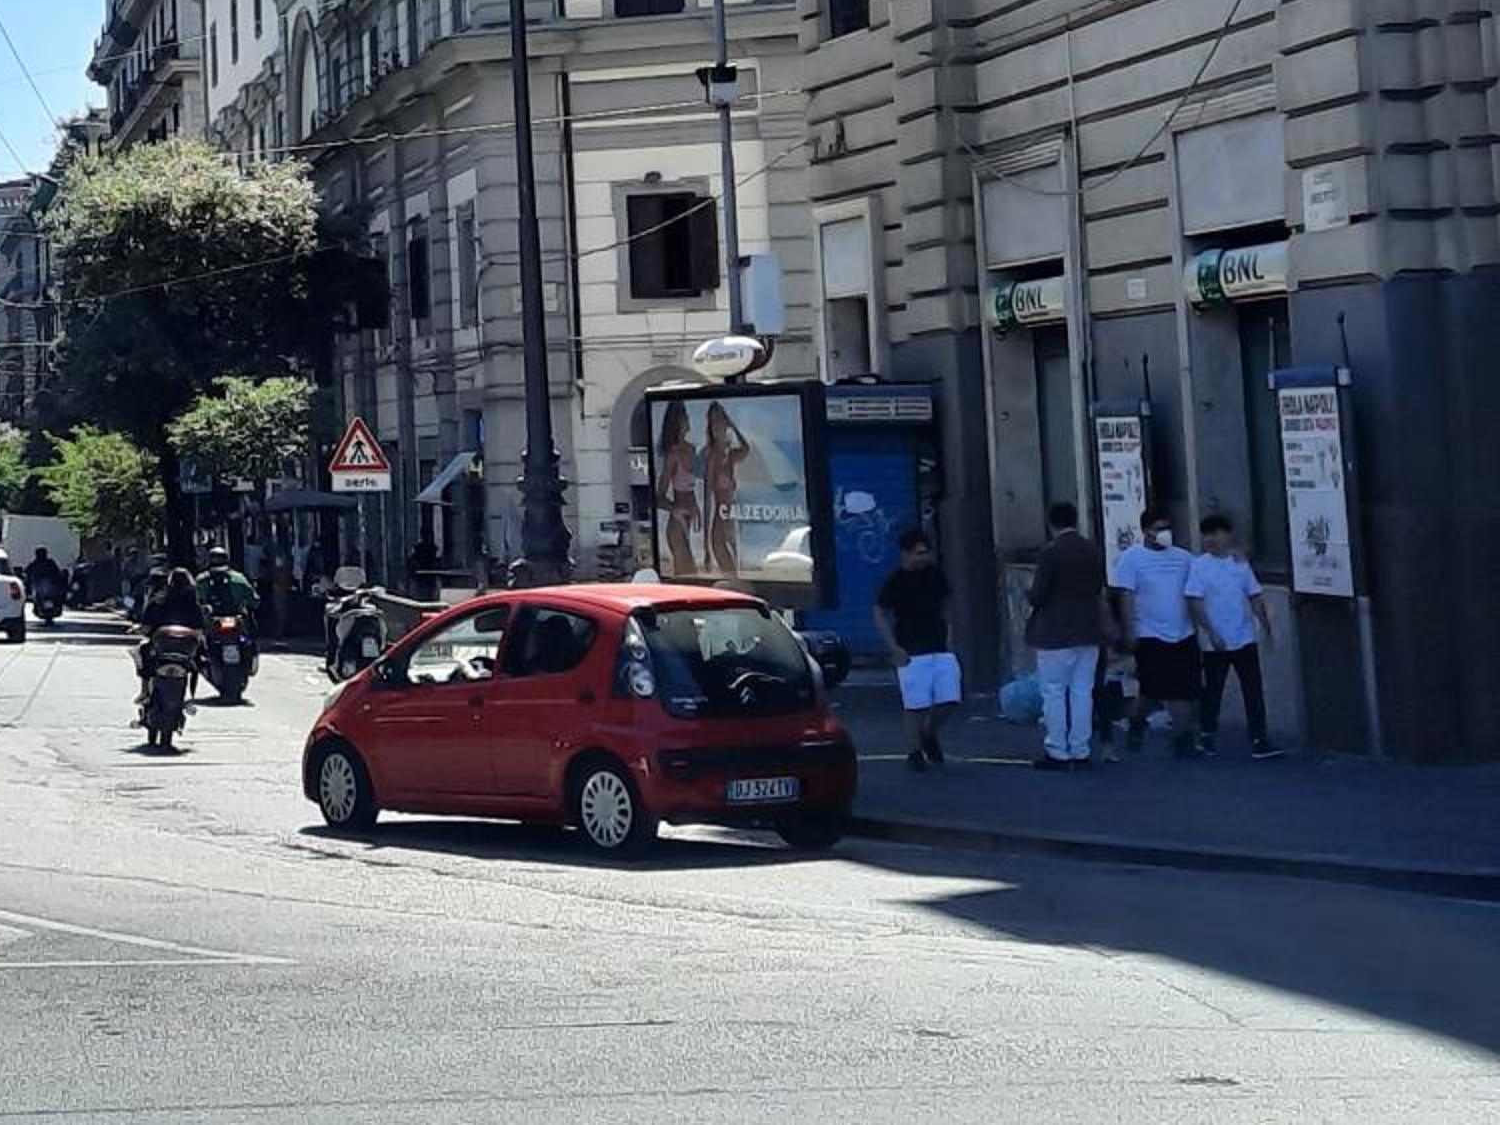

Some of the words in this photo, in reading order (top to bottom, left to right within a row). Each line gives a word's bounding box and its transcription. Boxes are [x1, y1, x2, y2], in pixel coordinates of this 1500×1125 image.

[1223, 250, 1265, 285] BNL
[1015, 284, 1048, 311] BNL
[719, 503, 805, 522] CALZEDONIA
